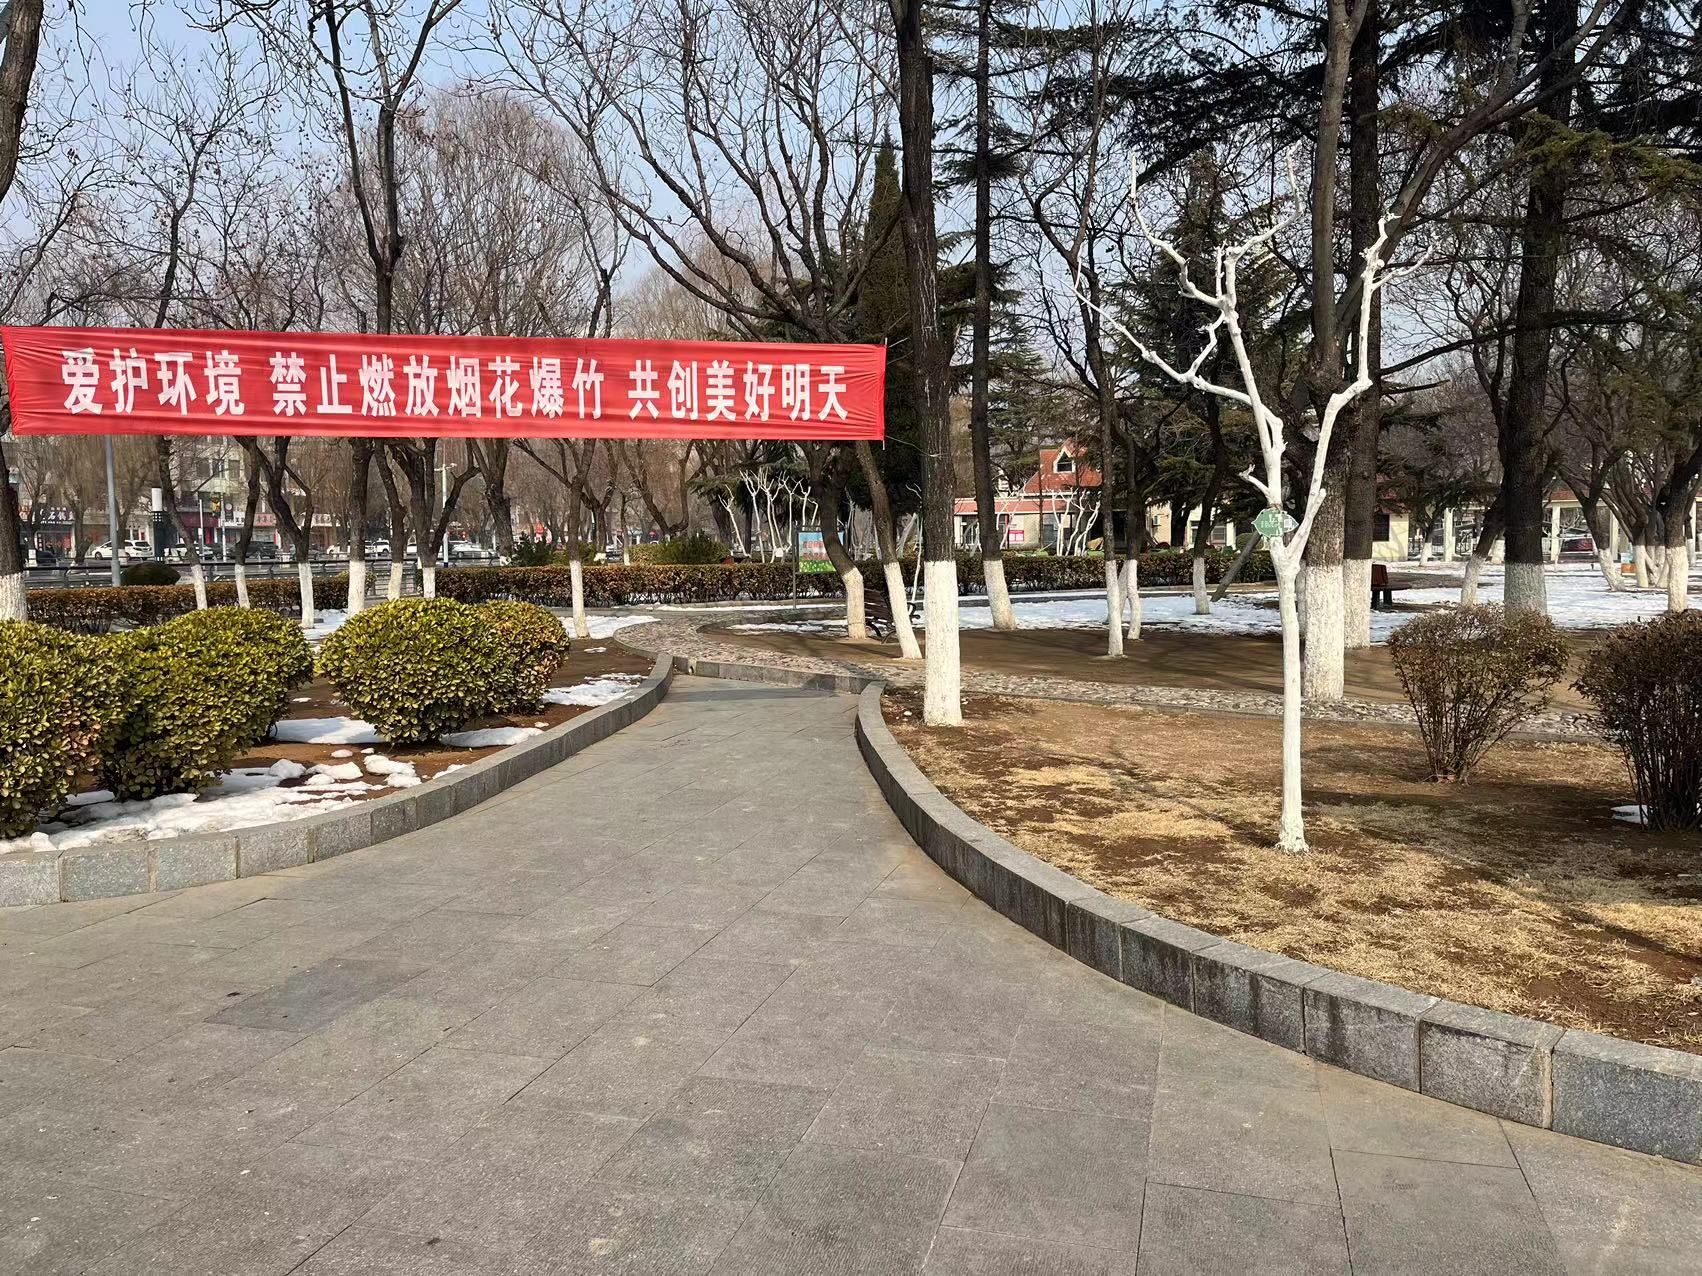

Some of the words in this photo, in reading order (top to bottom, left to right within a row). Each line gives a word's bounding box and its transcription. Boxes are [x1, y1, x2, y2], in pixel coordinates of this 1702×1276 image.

[61, 347, 246, 417] 爱护环境
[269, 351, 605, 420] 禁止燃放烟花爆竹
[627, 359, 849, 422] 共创美好明天
